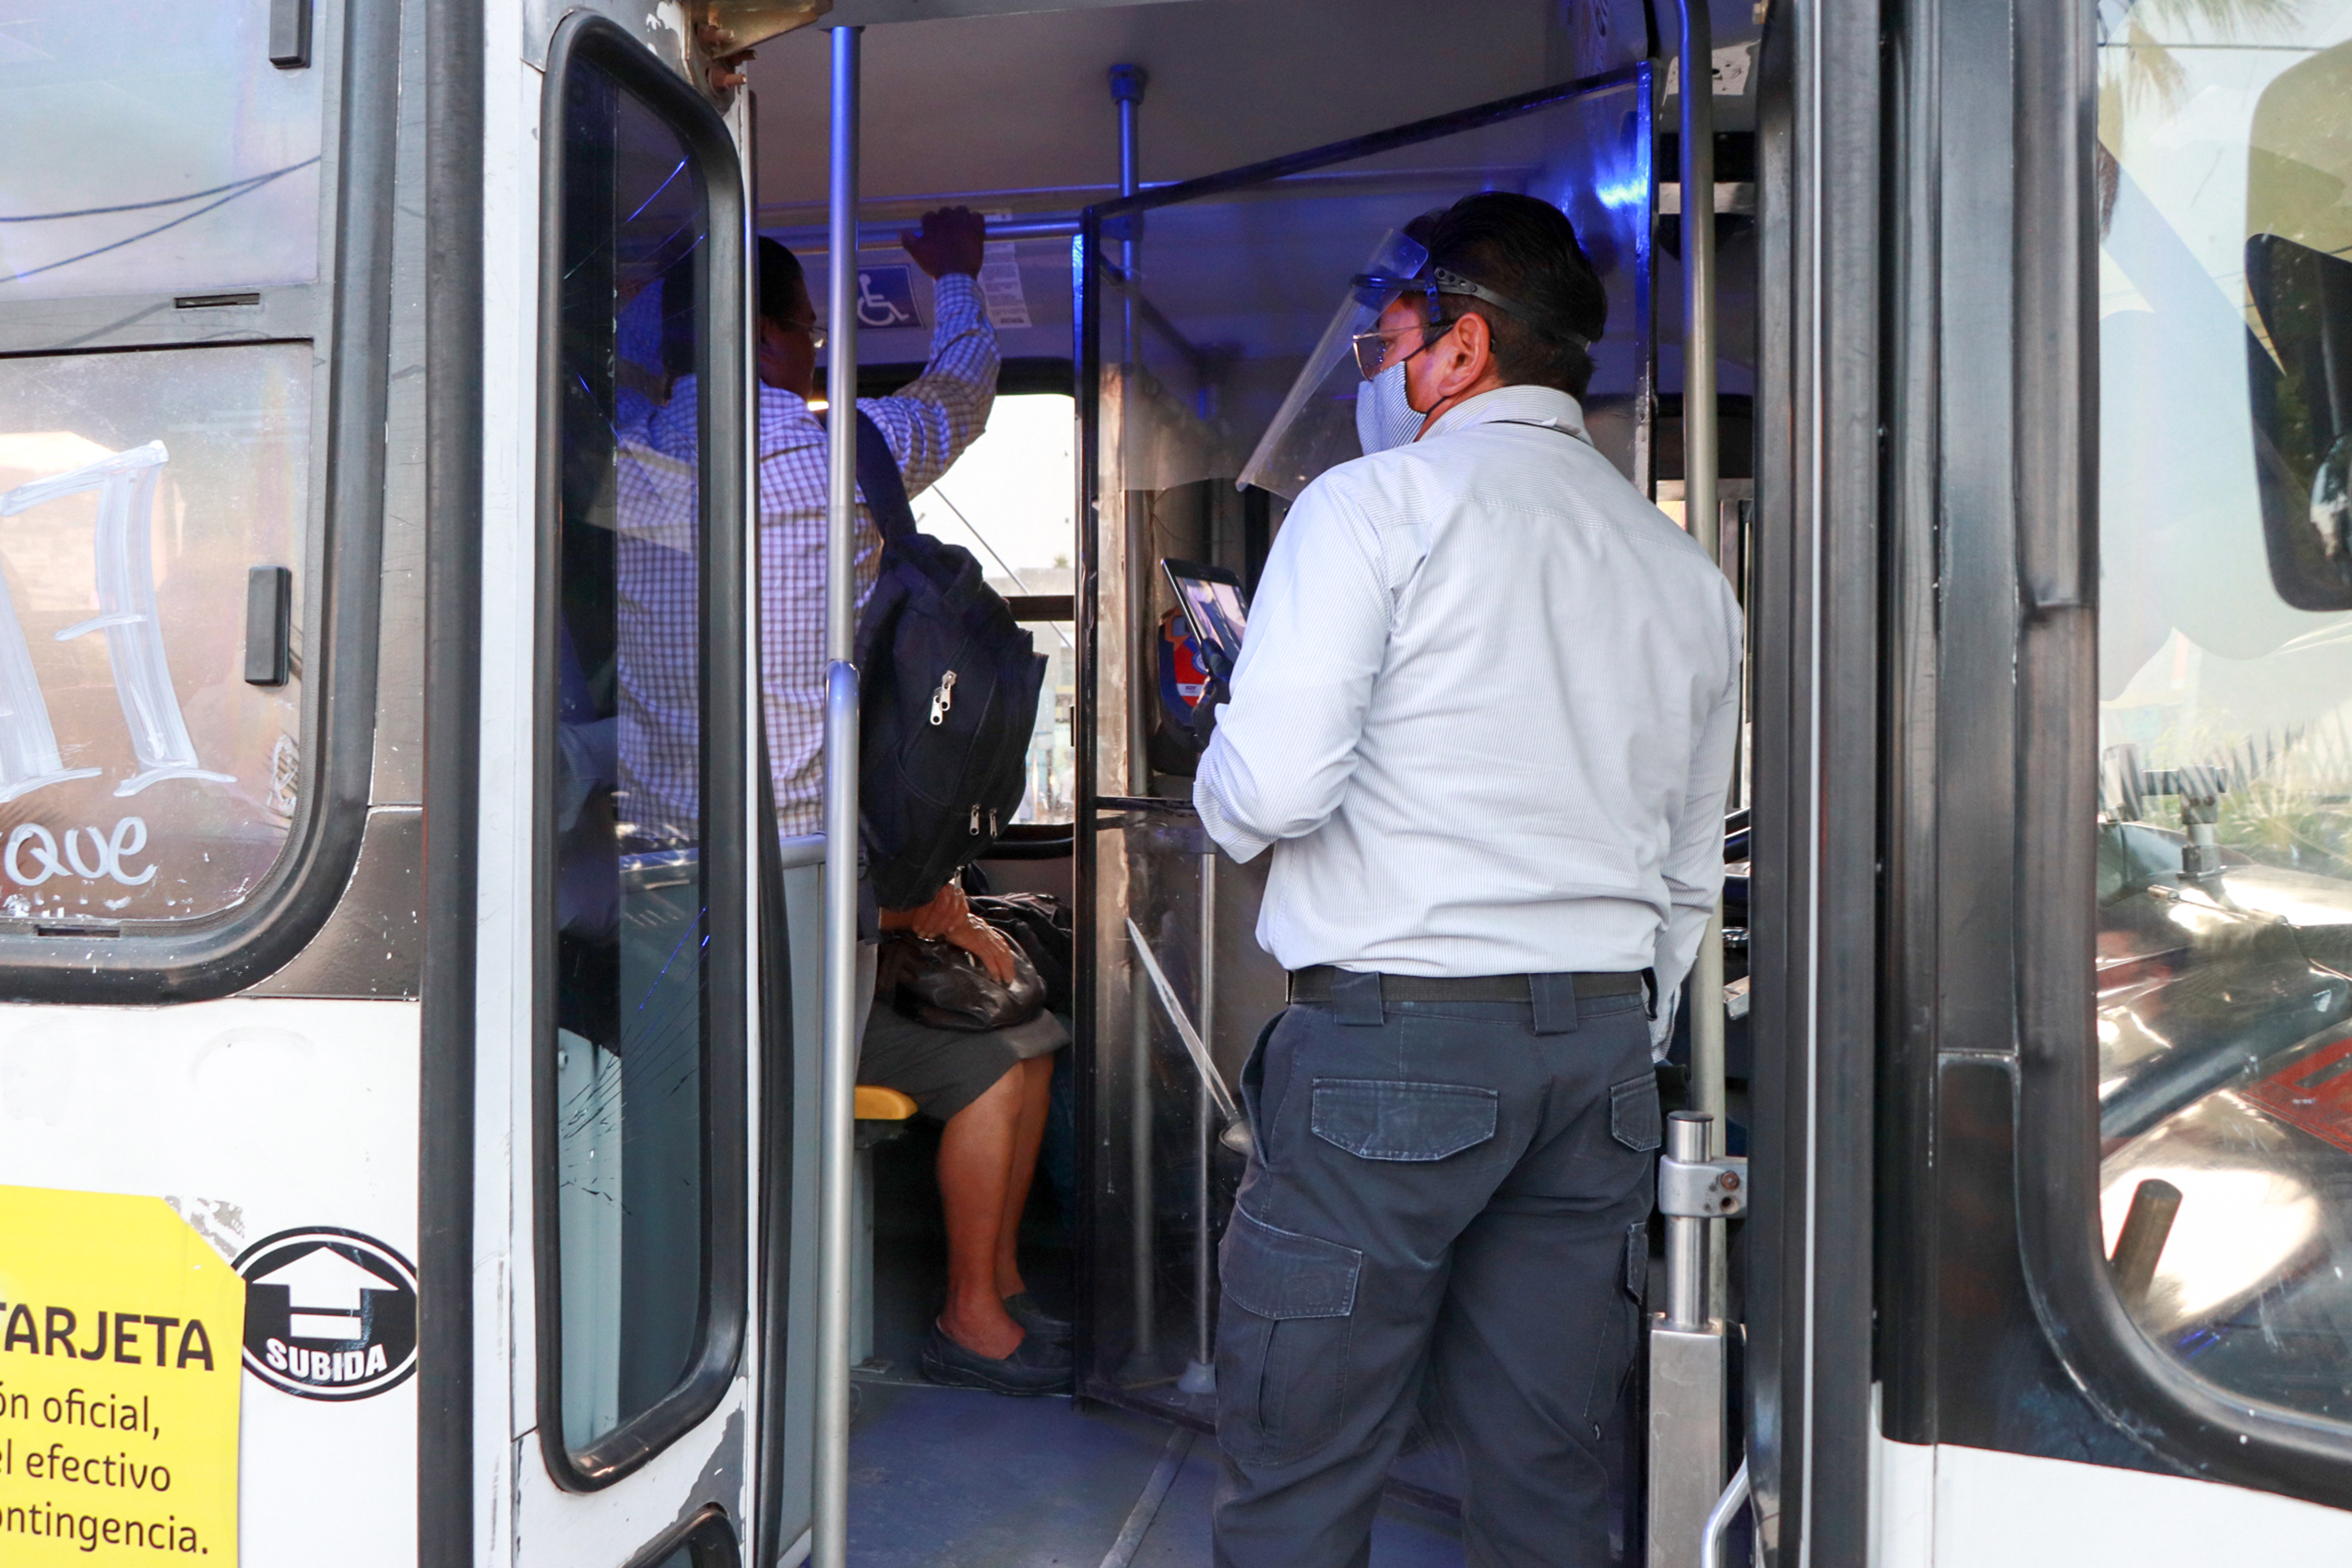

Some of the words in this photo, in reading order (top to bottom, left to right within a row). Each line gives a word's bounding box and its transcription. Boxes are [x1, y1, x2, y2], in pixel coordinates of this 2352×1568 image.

[0, 1301, 215, 1372] ARJETA
[266, 1337, 388, 1382] SUBIDA
[43, 1387, 160, 1441] oficial,
[0, 1438, 12, 1476] l
[26, 1443, 172, 1492] efectivo
[0, 1502, 208, 1553] ntingencia.
